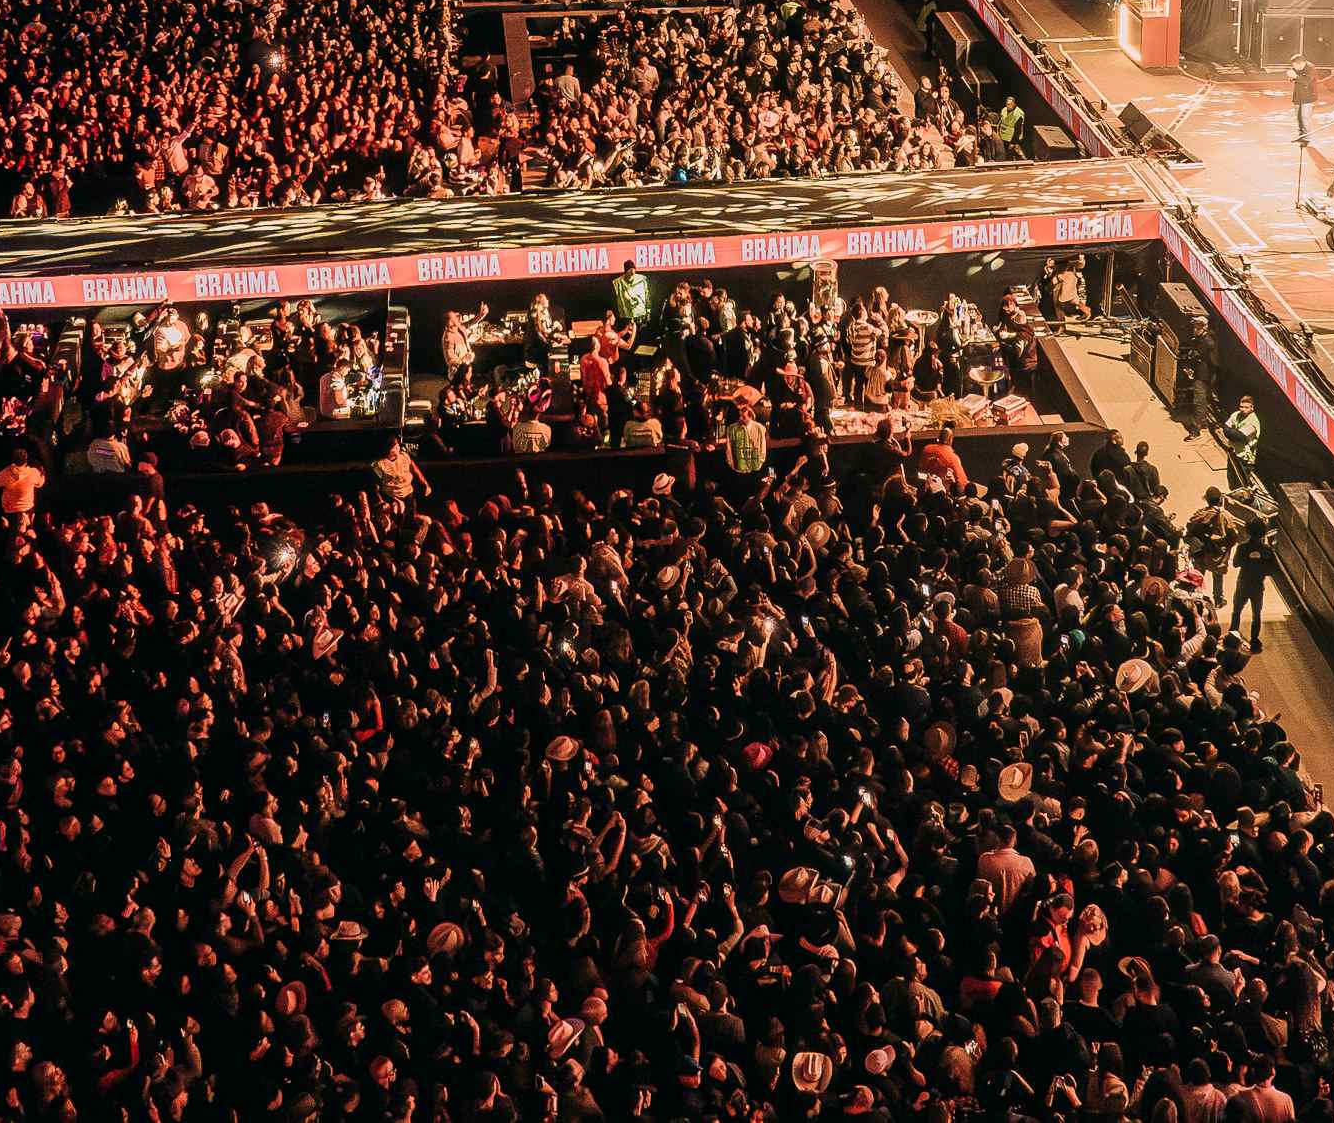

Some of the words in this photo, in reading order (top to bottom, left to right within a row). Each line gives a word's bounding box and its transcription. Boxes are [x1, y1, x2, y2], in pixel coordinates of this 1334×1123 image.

[82, 275, 168, 302] BRAHMA
[195, 270, 281, 296] BRAHMA
[305, 262, 392, 292] BRAHMA
[417, 253, 502, 282] BRAHMA
[527, 247, 610, 275] BRAHMA
[635, 242, 716, 269] BRAHMA
[741, 235, 821, 262] BRAHMA
[847, 229, 927, 255] BRAHMA
[952, 221, 1030, 249] BRAHMA
[1056, 215, 1133, 241] BRAHMA
